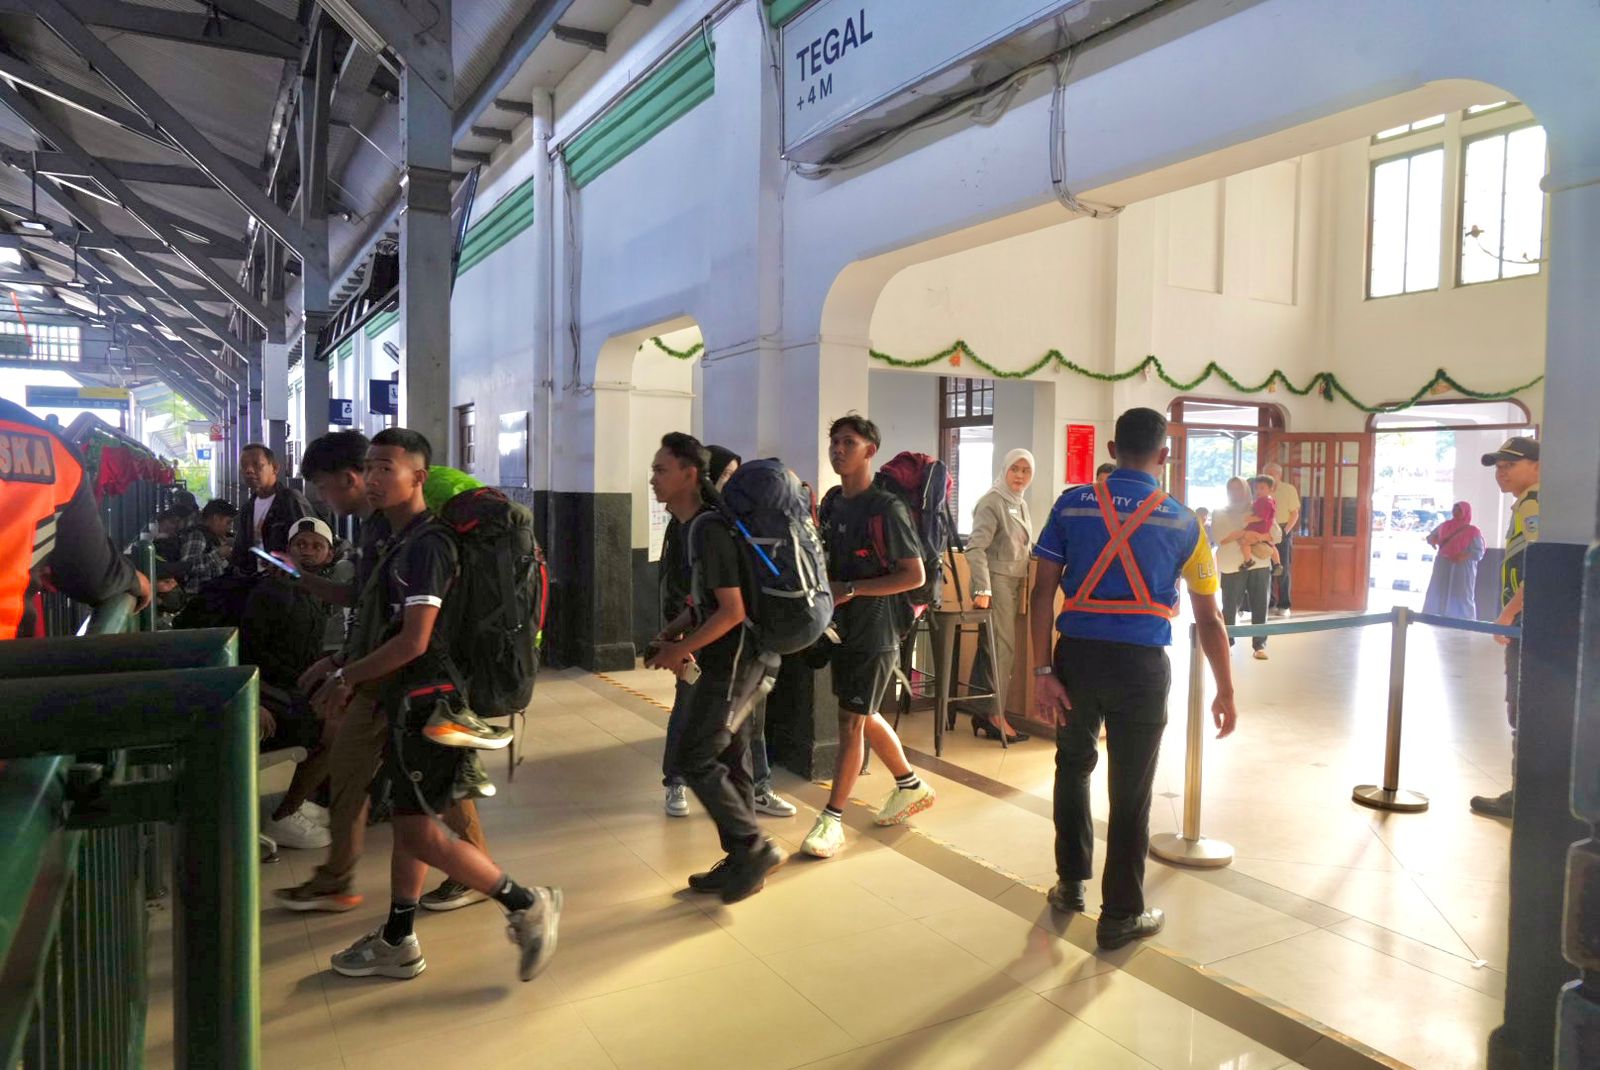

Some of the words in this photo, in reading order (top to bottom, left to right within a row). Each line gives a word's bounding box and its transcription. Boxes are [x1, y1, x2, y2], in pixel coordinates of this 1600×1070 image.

[796, 8, 873, 82] TEGAL
[820, 72, 833, 100] M
[1080, 492, 1132, 507] FAITY
[1136, 500, 1170, 513] CRE
